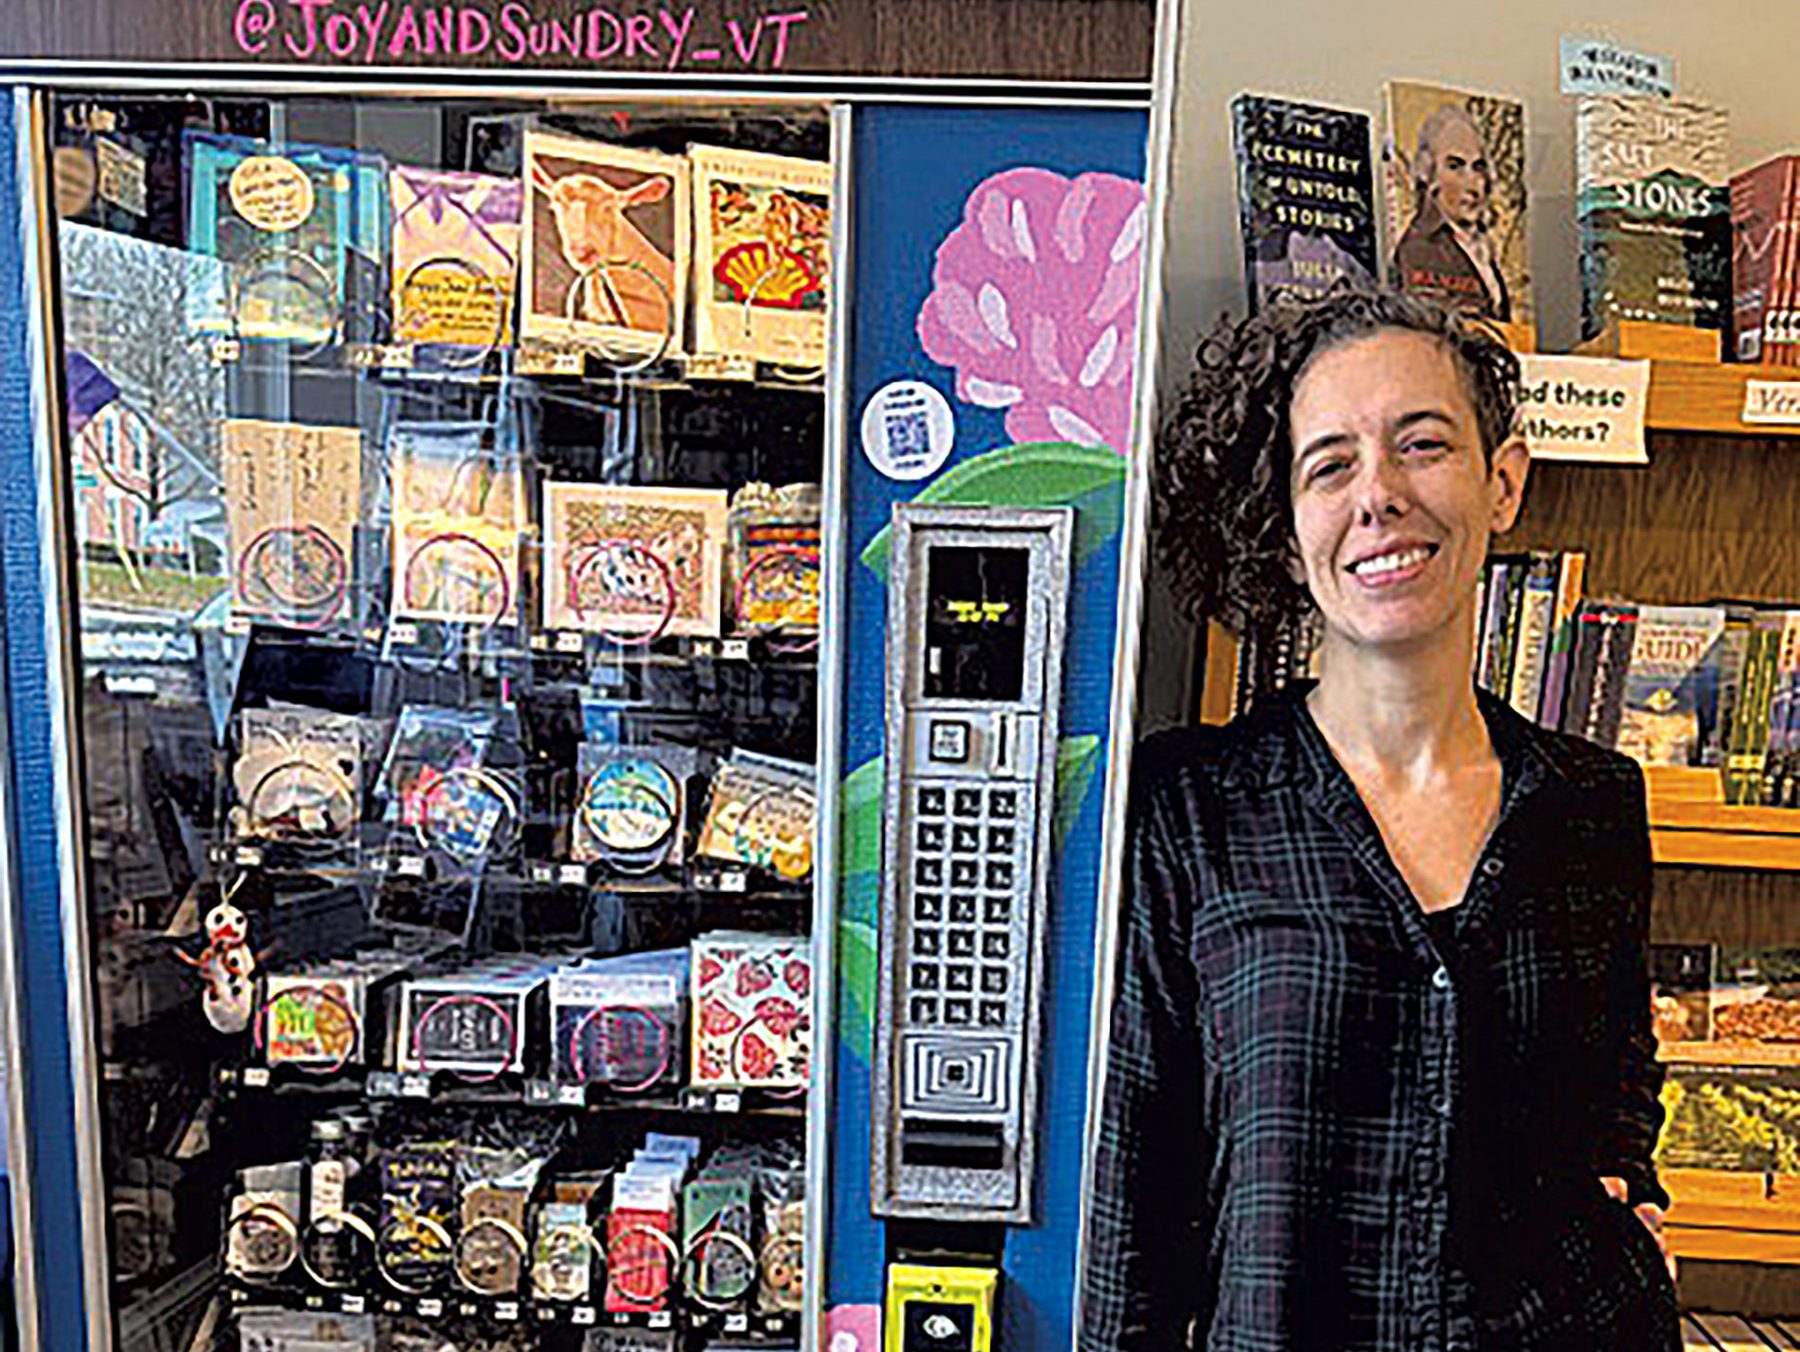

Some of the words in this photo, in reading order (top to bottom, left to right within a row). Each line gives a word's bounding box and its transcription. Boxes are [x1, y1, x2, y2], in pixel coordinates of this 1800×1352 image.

[1614, 182, 1712, 217] STONES
[1276, 205, 1355, 232] STORIES
[1554, 381, 1626, 408] these
[1511, 418, 1610, 442] uthors?
